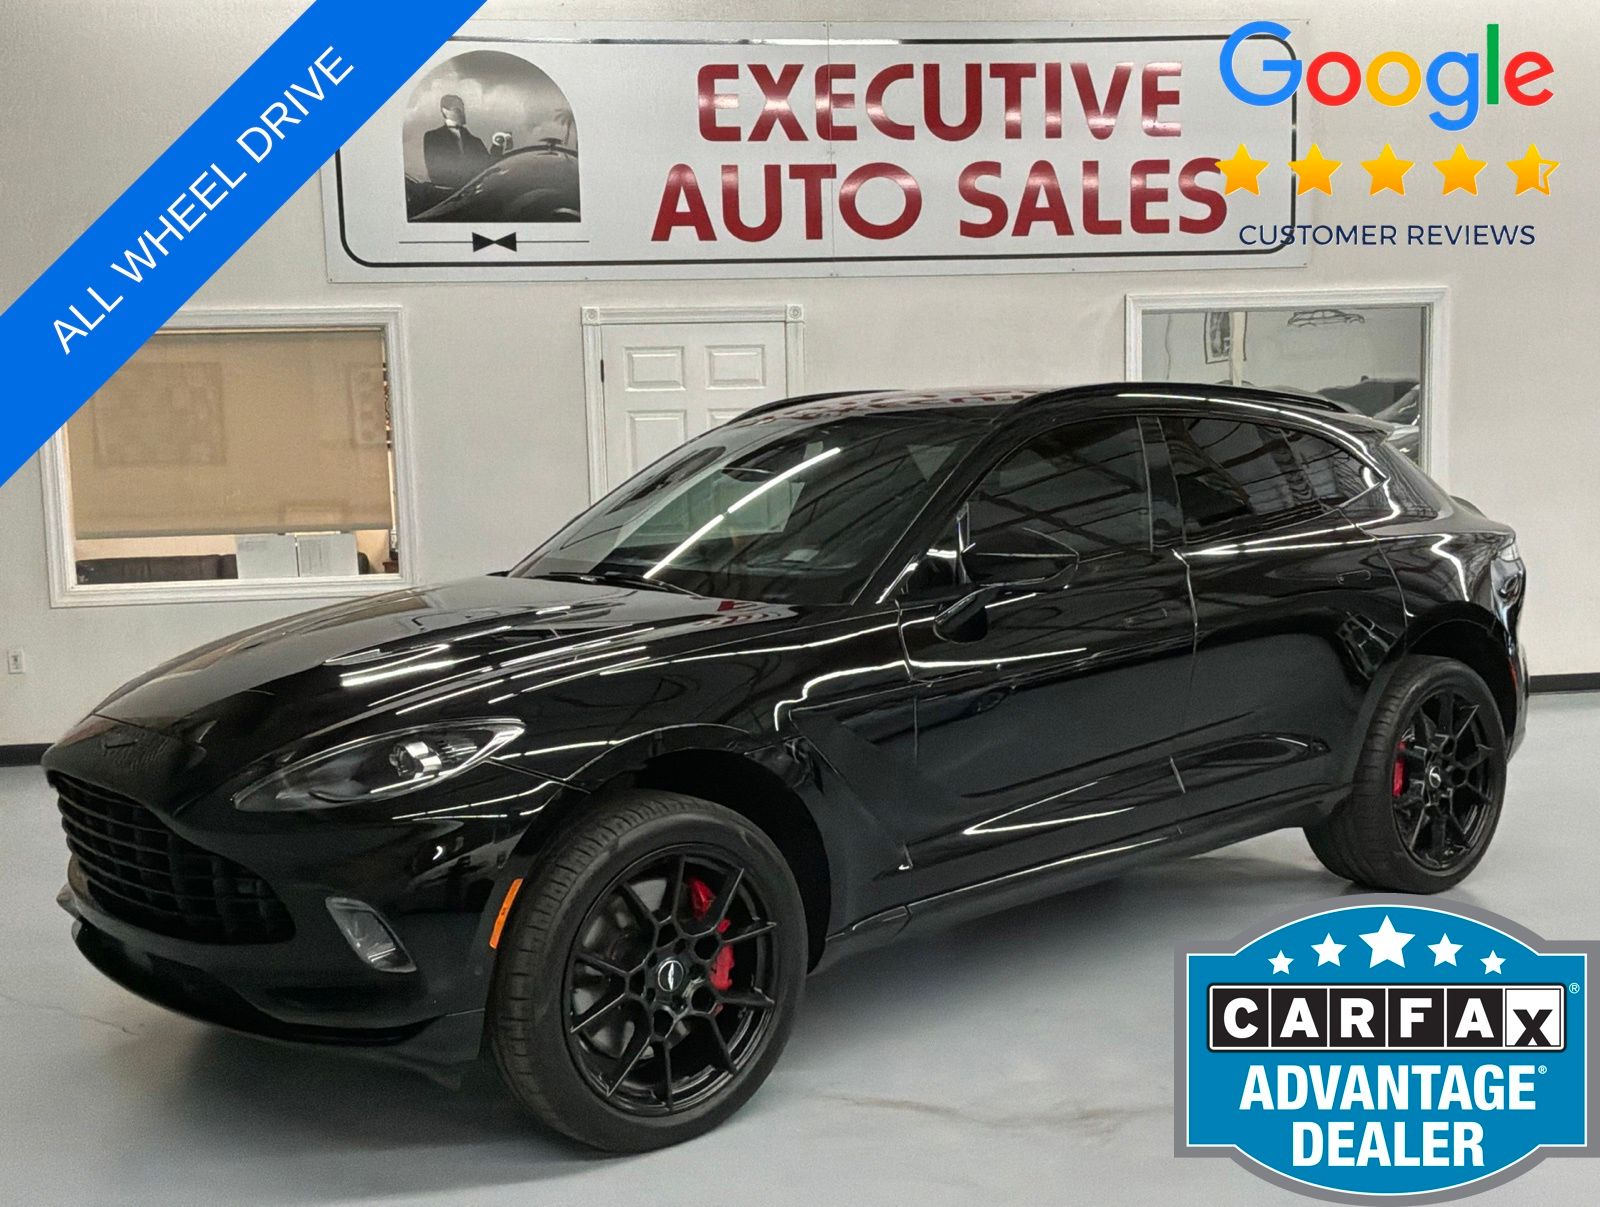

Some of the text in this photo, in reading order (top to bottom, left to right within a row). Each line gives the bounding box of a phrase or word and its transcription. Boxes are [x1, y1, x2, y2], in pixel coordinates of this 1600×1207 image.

[697, 62, 1181, 142] EXECUTIVE
[651, 157, 1227, 242] AUTO SALES
